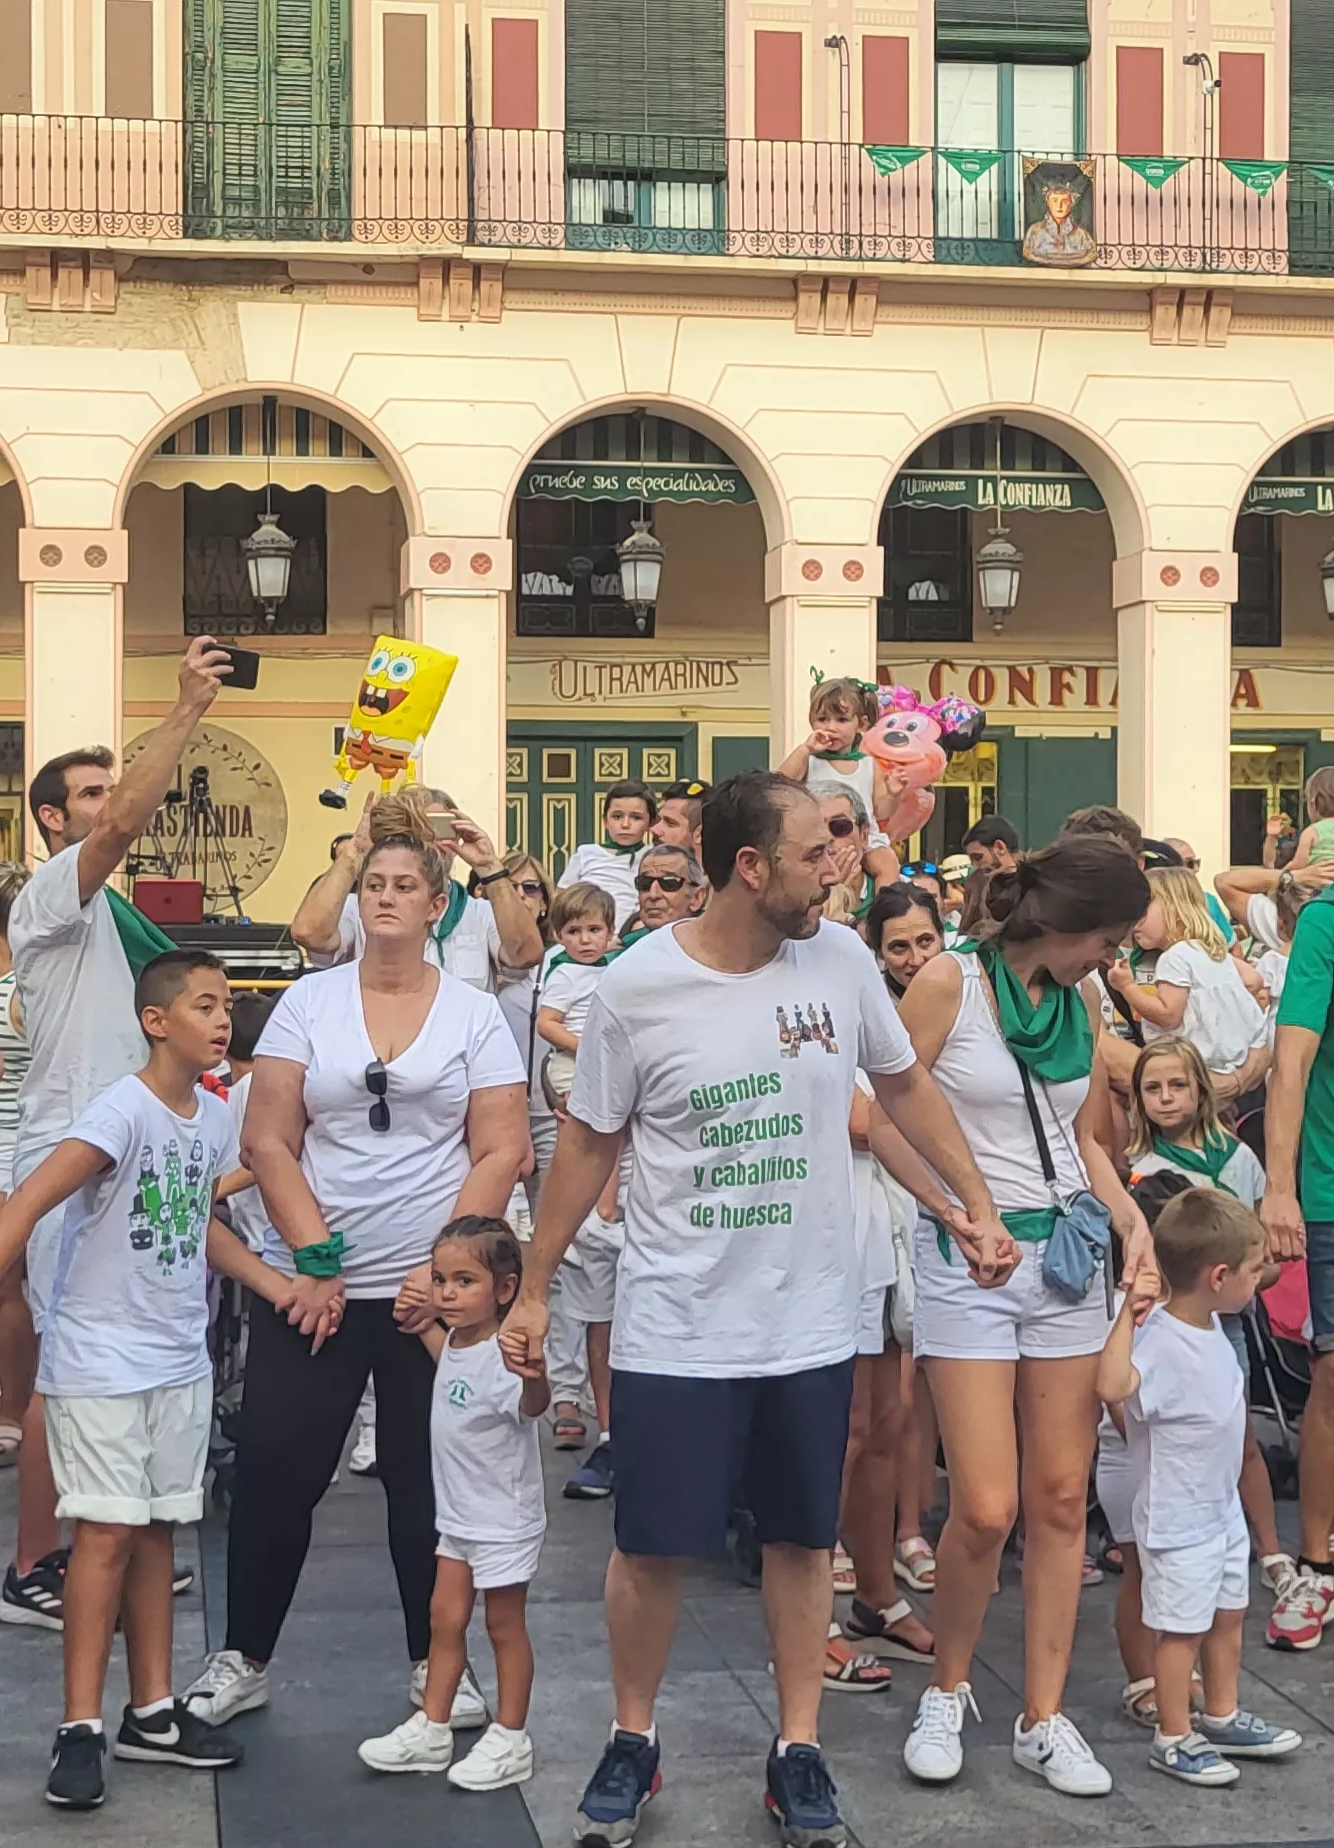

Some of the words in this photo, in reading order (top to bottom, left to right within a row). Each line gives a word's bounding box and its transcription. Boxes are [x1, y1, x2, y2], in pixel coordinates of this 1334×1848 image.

[529, 470, 586, 493] pruebe
[592, 474, 619, 490] sus
[626, 472, 736, 497] especialidades
[977, 479, 995, 505] LA
[999, 479, 1071, 507] CONFIANZA
[1317, 485, 1334, 511] LA
[558, 659, 739, 699] ULTRAMARINOS
[699, 1112, 804, 1148] cabezudos
[693, 1165, 705, 1188] y
[711, 1155, 808, 1188] caballitos
[690, 1202, 714, 1228] de
[720, 1202, 792, 1230] huesca
